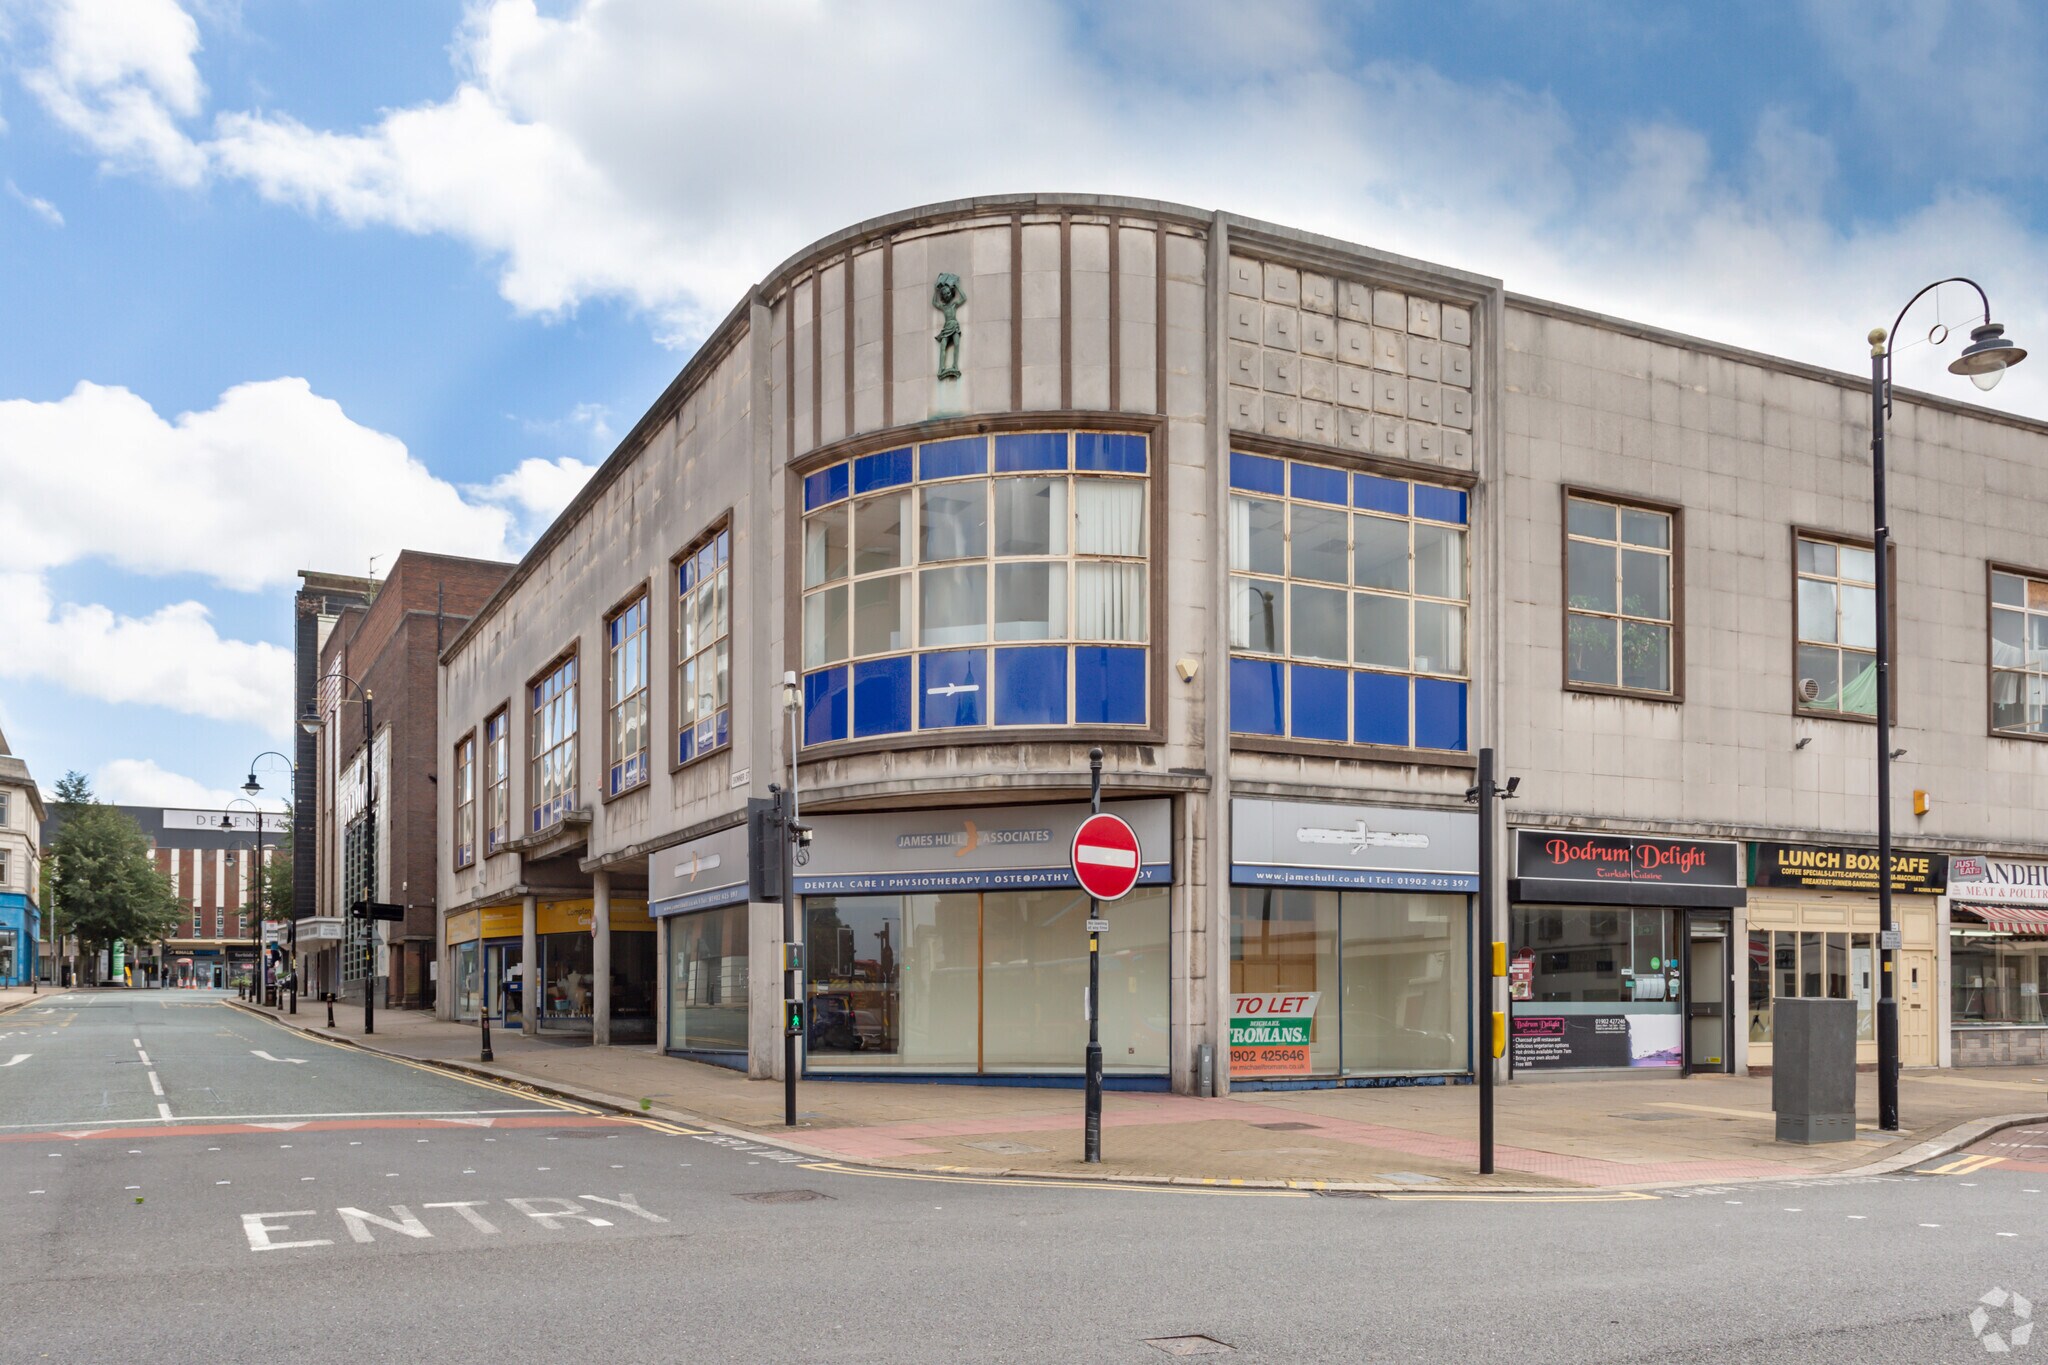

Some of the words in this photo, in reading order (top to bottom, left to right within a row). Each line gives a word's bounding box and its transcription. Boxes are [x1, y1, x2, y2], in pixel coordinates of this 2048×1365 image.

[898, 835, 933, 847] JAMES
[935, 834, 963, 845] HULL
[983, 830, 1049, 843] ASSOCIATES
[1545, 839, 1630, 865] Bodrum
[1636, 844, 1706, 874] Delight
[1778, 849, 1840, 869] LUNCH
[1845, 854, 1880, 870] BOX
[1955, 860, 1976, 868] JUST
[1256, 871, 1365, 884] www.jameshull.co.uk
[1375, 876, 1394, 885] Tel:
[1397, 878, 1427, 886] 01902
[1430, 878, 1448, 886] 425
[1452, 879, 1469, 887] 397
[1596, 867, 1631, 878] Turkish
[1632, 869, 1662, 880] Cuisine
[1781, 867, 1802, 876] COFFEE
[1960, 867, 1975, 875] EAT
[804, 881, 845, 889] DENTAL
[849, 880, 877, 888] CARE
[889, 876, 980, 887] PHYSIOTHERAPY
[994, 873, 1069, 883] OSTEOPATHY
[1966, 886, 1996, 897] MEAT
[1998, 888, 2006, 897] &
[1236, 997, 1263, 1014] TO
[1267, 997, 1309, 1013] LET
[1261, 1050, 1305, 1062] 425646
[240, 1193, 670, 1251] ENTRY
